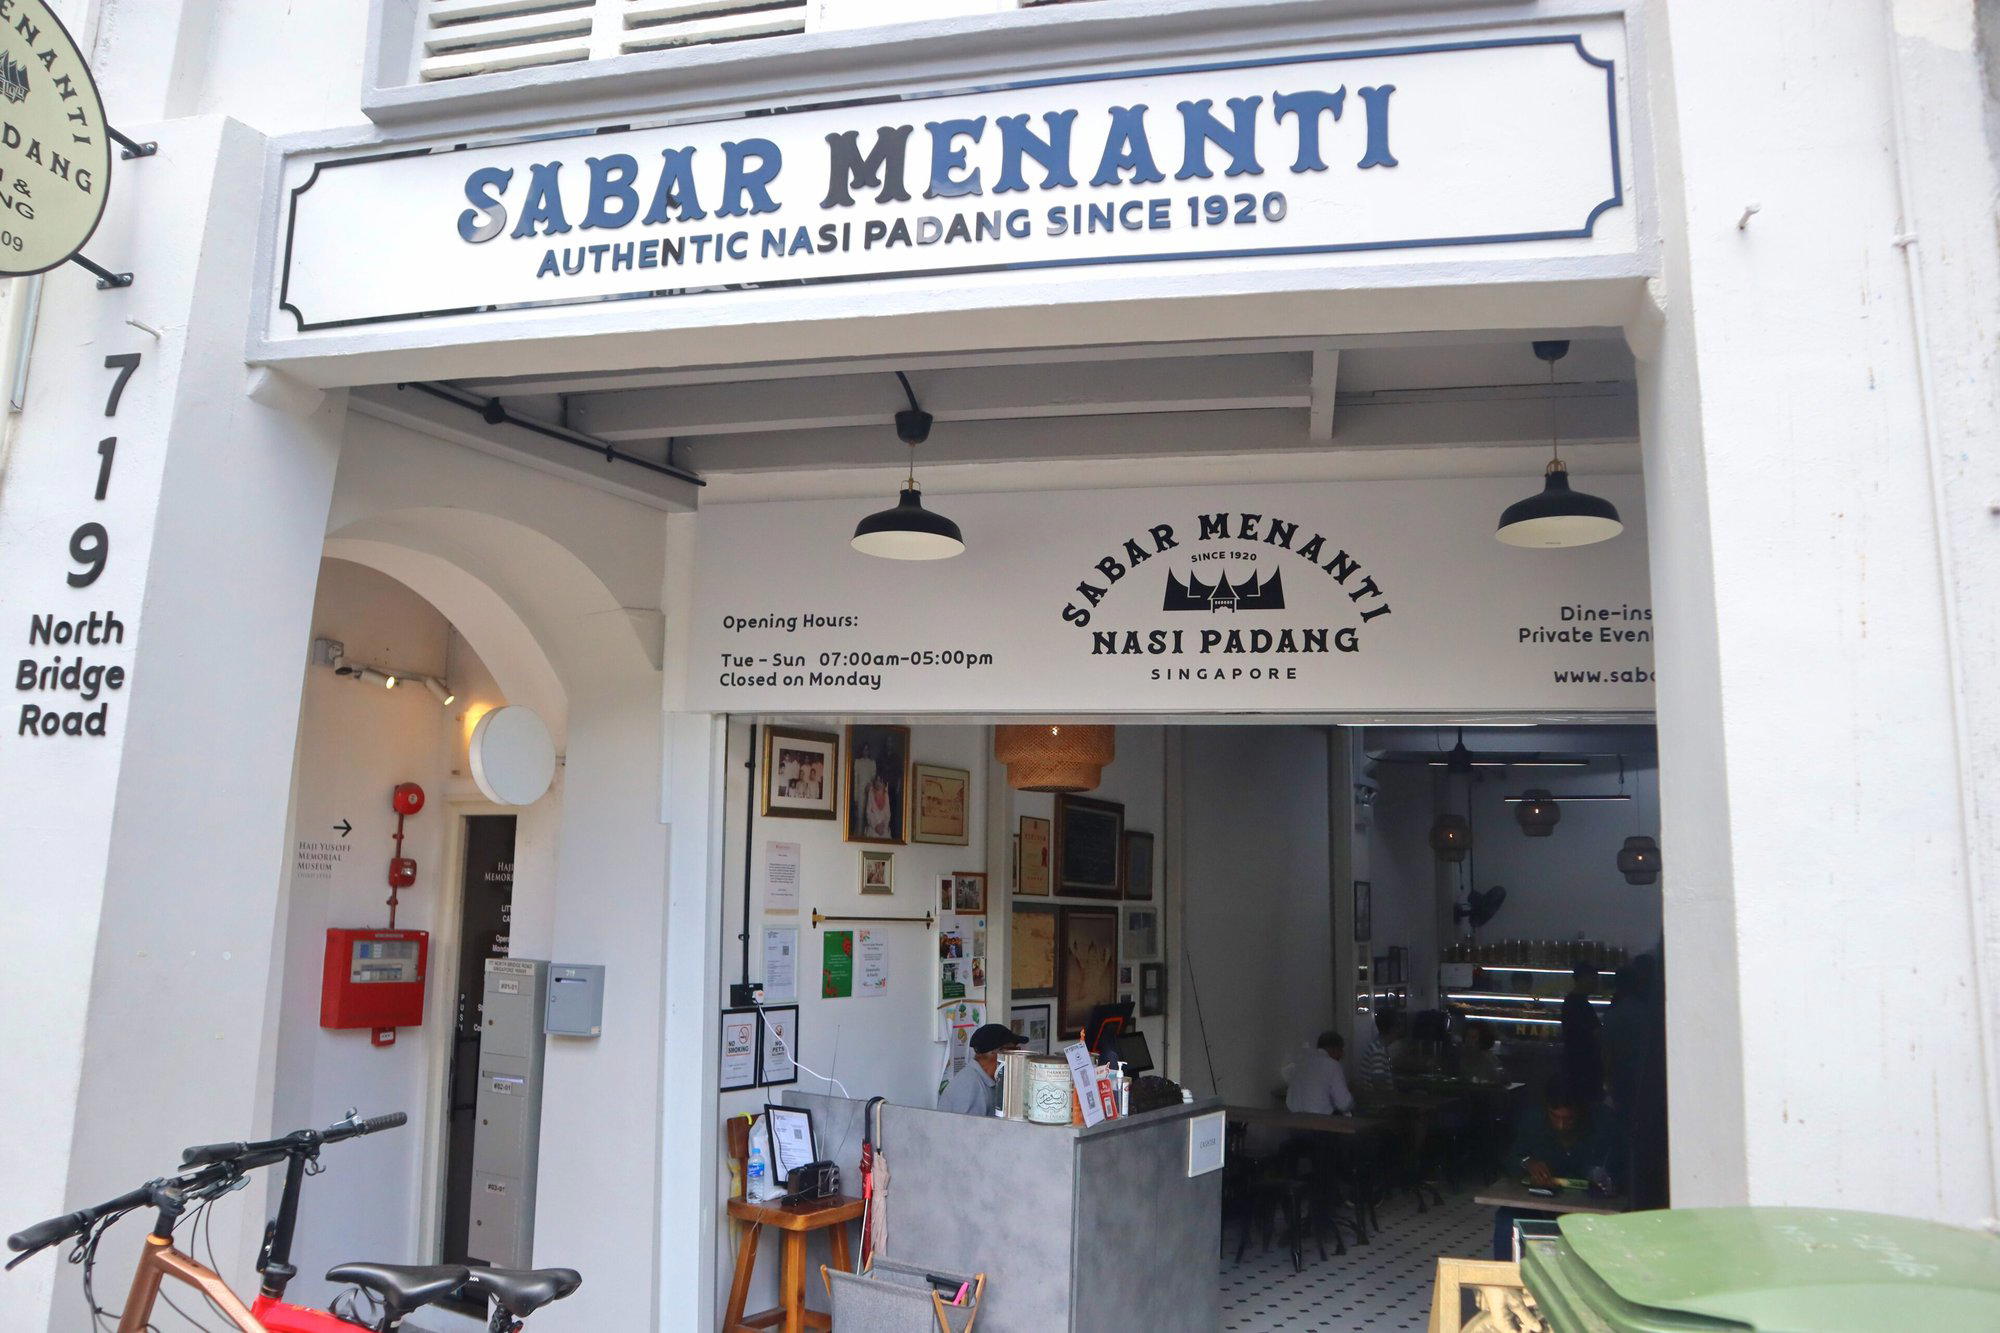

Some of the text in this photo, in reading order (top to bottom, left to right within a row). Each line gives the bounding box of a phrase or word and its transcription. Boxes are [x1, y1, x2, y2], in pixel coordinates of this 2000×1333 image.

[457, 83, 1399, 243] SABAR MENANTI
[536, 191, 1288, 278] AUTHENTIC NASI PADANG SINCE 1920
[1190, 550, 1258, 563] SINCE 1920
[1062, 512, 1392, 628] SABAR MENANTI
[29, 610, 125, 646] North
[722, 613, 859, 632] Opening Hours:
[1091, 627, 1360, 655] NASI PADANG
[1519, 626, 1594, 643] Private
[721, 653, 754, 667] Tue
[772, 653, 806, 667] Sun
[819, 650, 994, 669] 07:00am-05:00pm
[15, 655, 125, 701] Bridge
[719, 671, 882, 691] Closed on Monday
[1150, 667, 1298, 680] SINGAPORE
[18, 702, 108, 737] Road
[297, 862, 332, 871] MUSEUM
[298, 851, 342, 862] MEMORIAL
